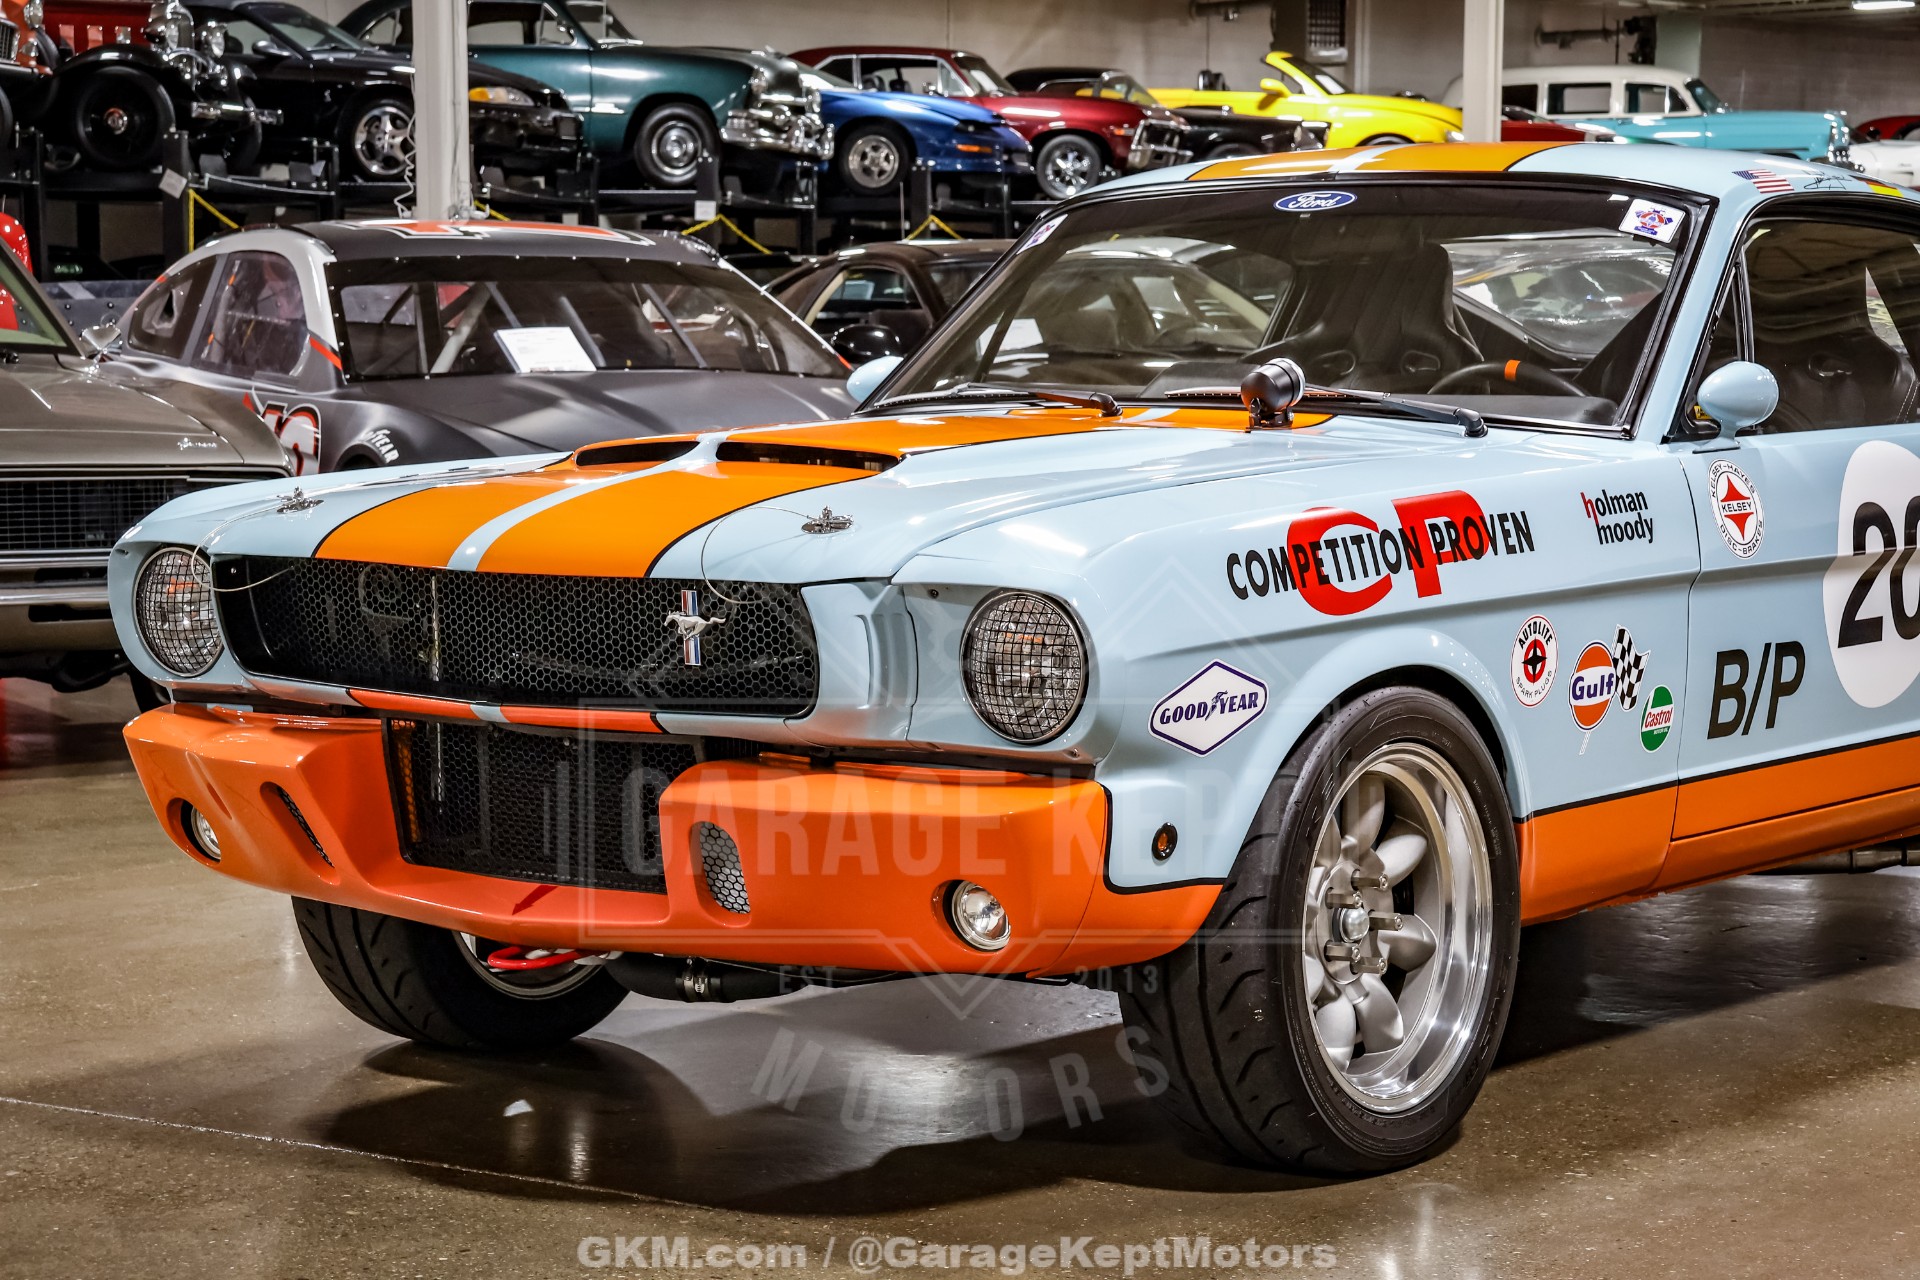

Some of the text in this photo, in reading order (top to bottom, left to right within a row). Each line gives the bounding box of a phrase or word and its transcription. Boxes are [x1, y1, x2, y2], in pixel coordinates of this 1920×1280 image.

[1288, 193, 1341, 208] Ford
[1580, 489, 1648, 526] holman
[1721, 501, 1752, 513] KELSEY
[1597, 511, 1654, 545] moody
[1226, 510, 1536, 600] COMPETITION PROVEN
[1518, 620, 1553, 650] AUTOLITE
[1571, 673, 1615, 701] Gulf
[1706, 641, 1806, 740] B/P
[1644, 706, 1674, 728] Castrol
